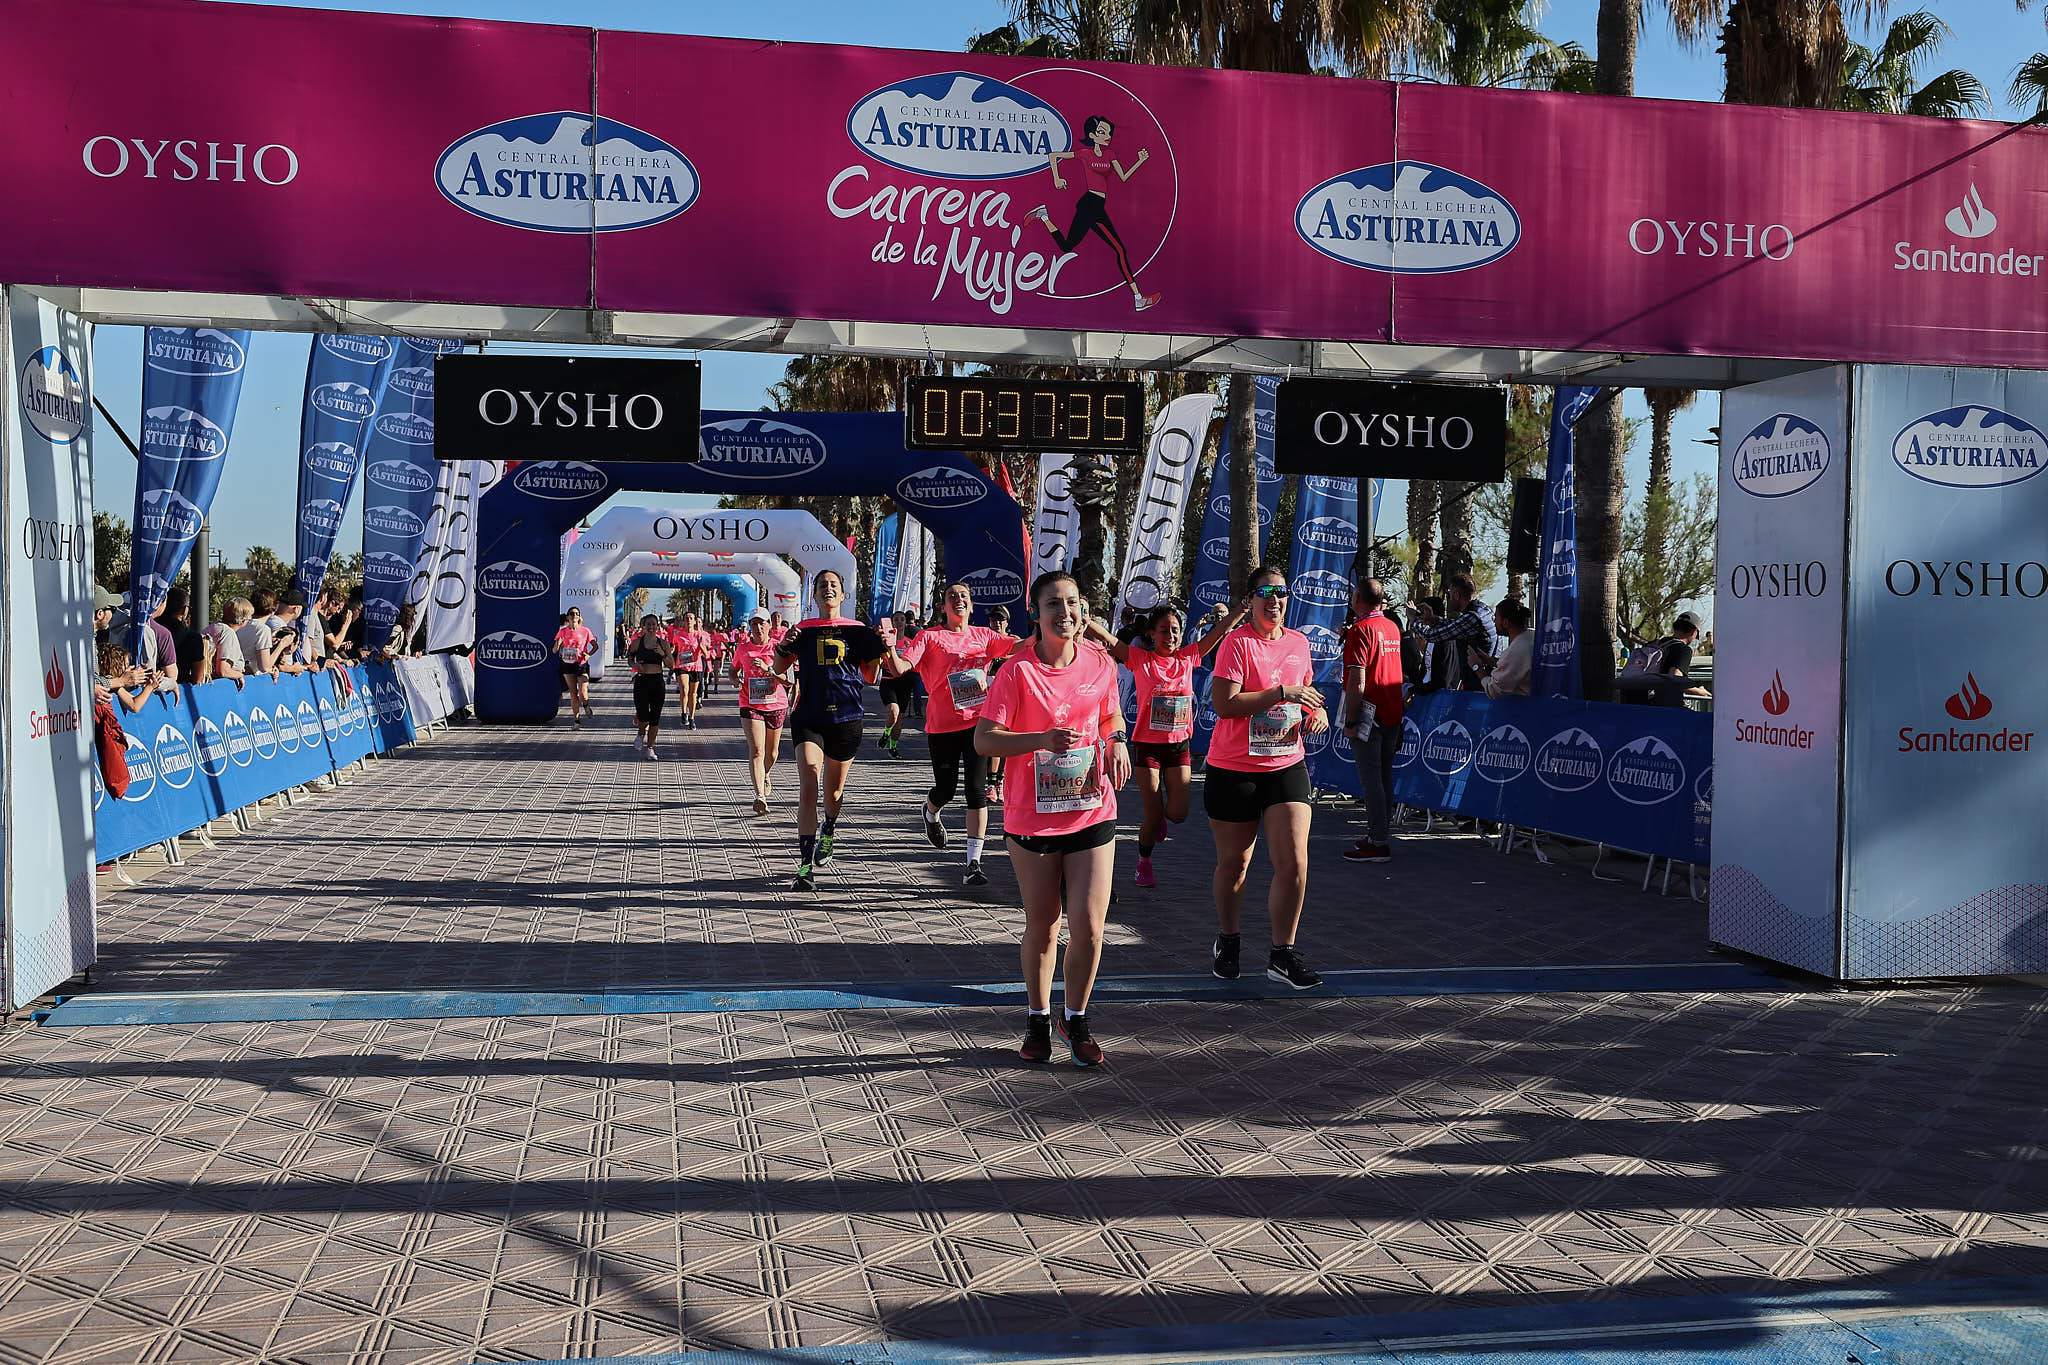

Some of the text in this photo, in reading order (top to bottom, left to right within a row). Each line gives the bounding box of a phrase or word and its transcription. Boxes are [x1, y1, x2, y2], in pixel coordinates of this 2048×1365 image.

[864, 105, 1054, 156] ASTURIANA
[900, 105, 1049, 125] CENTRAL LECHERA
[82, 135, 299, 186] OYSHO
[497, 150, 580, 165] CENTRAL
[455, 151, 680, 204] ASTURIANA
[826, 165, 1011, 229] Carrera
[1348, 197, 1497, 215] CENTRAL LECHERA
[1312, 198, 1504, 247] ASTURIANA
[1628, 218, 1794, 262] OYSHO
[871, 225, 1078, 315] de la Mujer
[1894, 241, 2045, 277] Santander
[478, 388, 663, 431] OYSHO
[924, 388, 1127, 442] 00:37:35
[713, 434, 811, 445] CENTRAL LECHERA
[1313, 410, 1474, 451] OYSHO
[1752, 437, 1820, 455] CENTRAL LECHERA
[1928, 433, 2035, 444] CENTRAL LECHERA
[1738, 449, 1823, 481] ASTURIANA
[1903, 433, 2039, 468] ASTURIANA
[370, 466, 428, 488] ASTURIANA
[519, 471, 600, 490] ASTURIANA
[904, 482, 982, 498] ASTURIANA
[653, 516, 769, 542] OYSHO
[1124, 427, 1195, 615] OYSHO
[24, 516, 85, 564] OYSHO
[582, 542, 618, 550] OYSHO
[802, 543, 836, 552] OYSHO
[481, 573, 545, 591] ASTURIANA
[566, 588, 600, 597] OYSHO
[970, 584, 1021, 597] STURIANA
[1730, 560, 1827, 599] OYSHO
[1885, 559, 2048, 599] OYSHO
[479, 643, 542, 660] ASTURIANA
[30, 705, 82, 740] Santander
[1736, 718, 1814, 750] Santander
[1898, 726, 2034, 753] Santander
[1478, 743, 1525, 769] ASTURIANA
[1538, 749, 1596, 778] ASTURIANA
[1611, 757, 1675, 791] ASTURIANA
